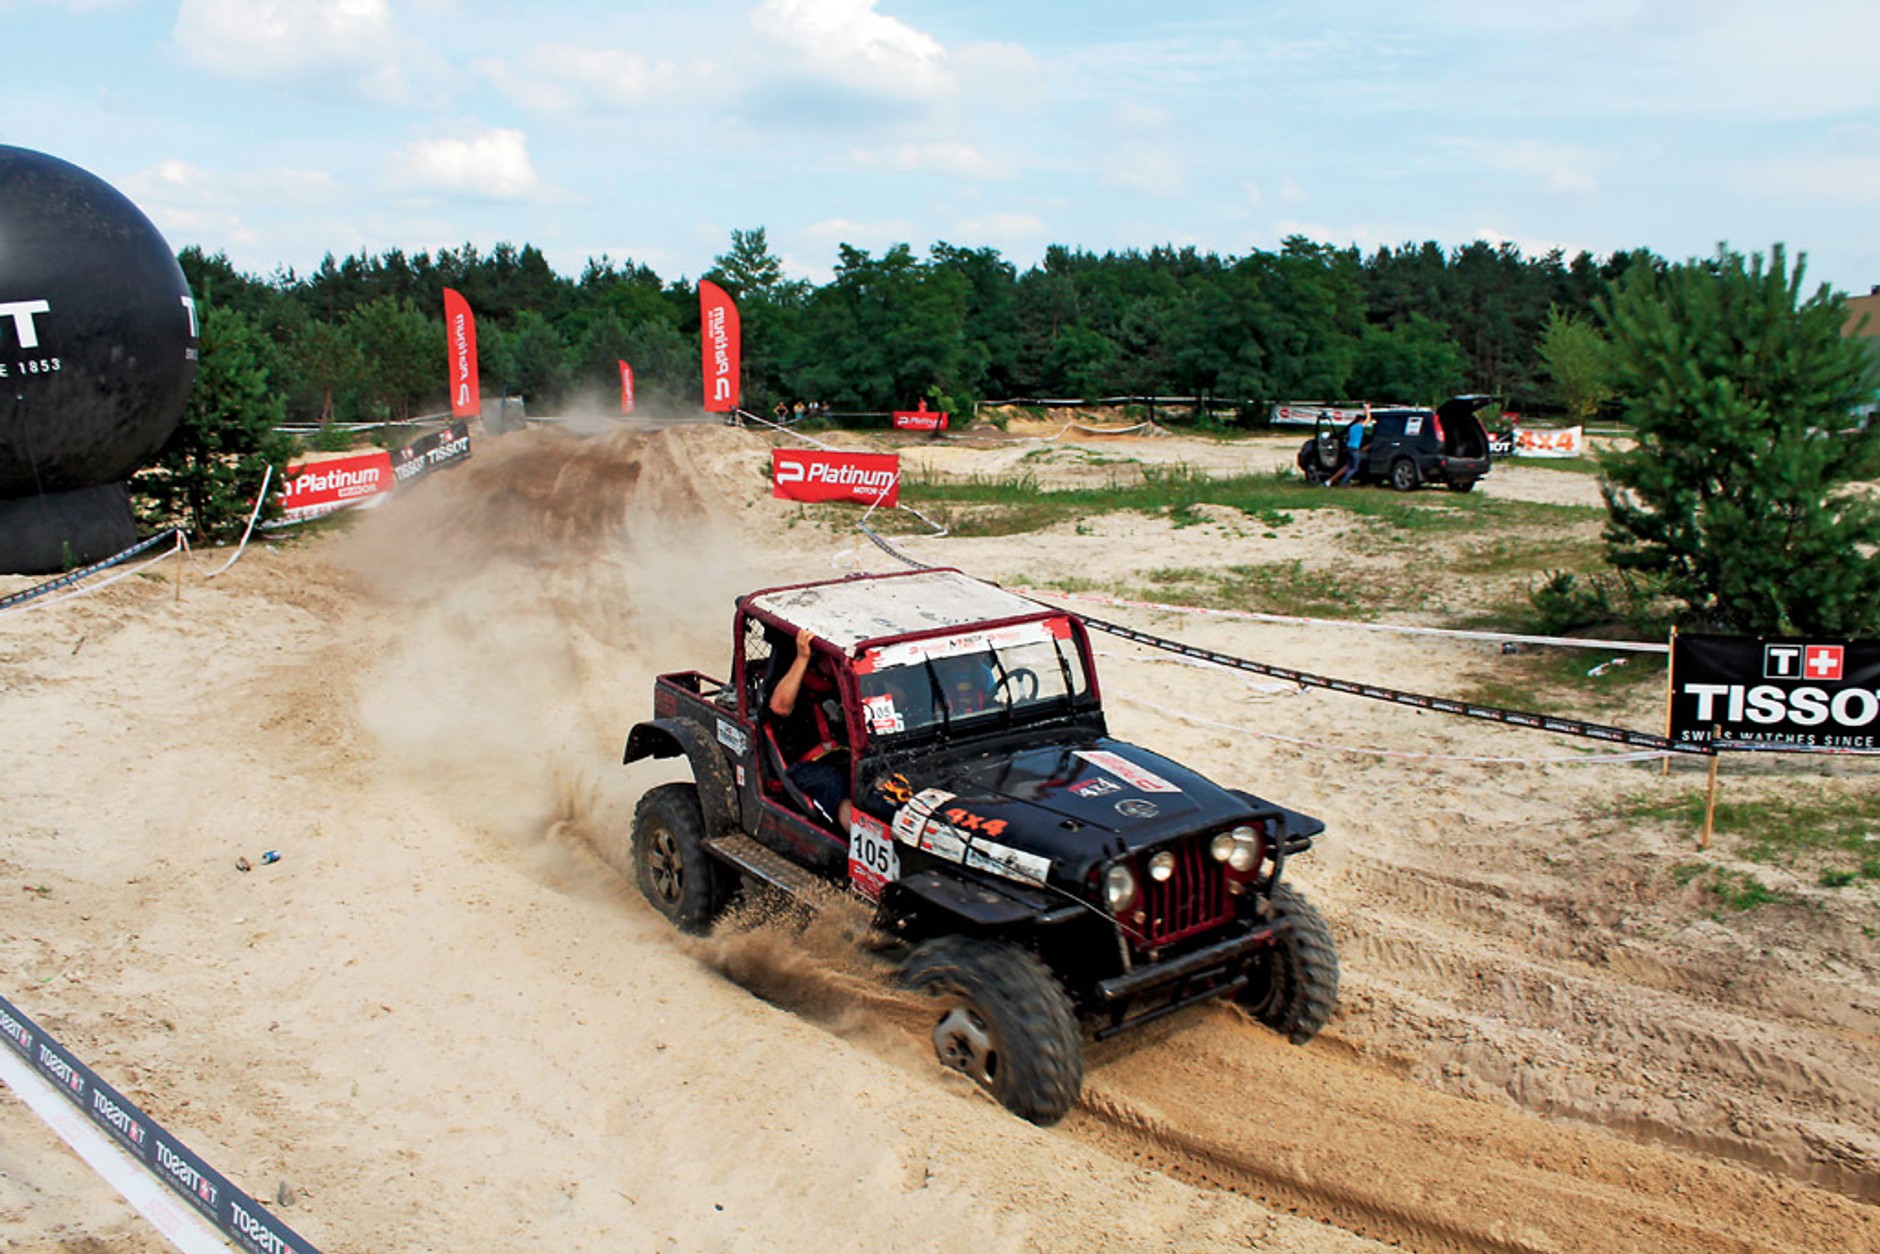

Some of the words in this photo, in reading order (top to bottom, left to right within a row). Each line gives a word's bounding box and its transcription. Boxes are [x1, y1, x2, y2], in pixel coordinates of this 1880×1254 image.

[18, 357, 61, 375] 1853
[426, 436, 469, 464] TISSOT
[295, 468, 380, 495] Platinum
[808, 462, 893, 487] Platinum
[1684, 683, 1880, 727] TISSO
[1681, 730, 1733, 742] SWIS
[1823, 735, 1875, 747] SINCE
[853, 833, 889, 873] 105
